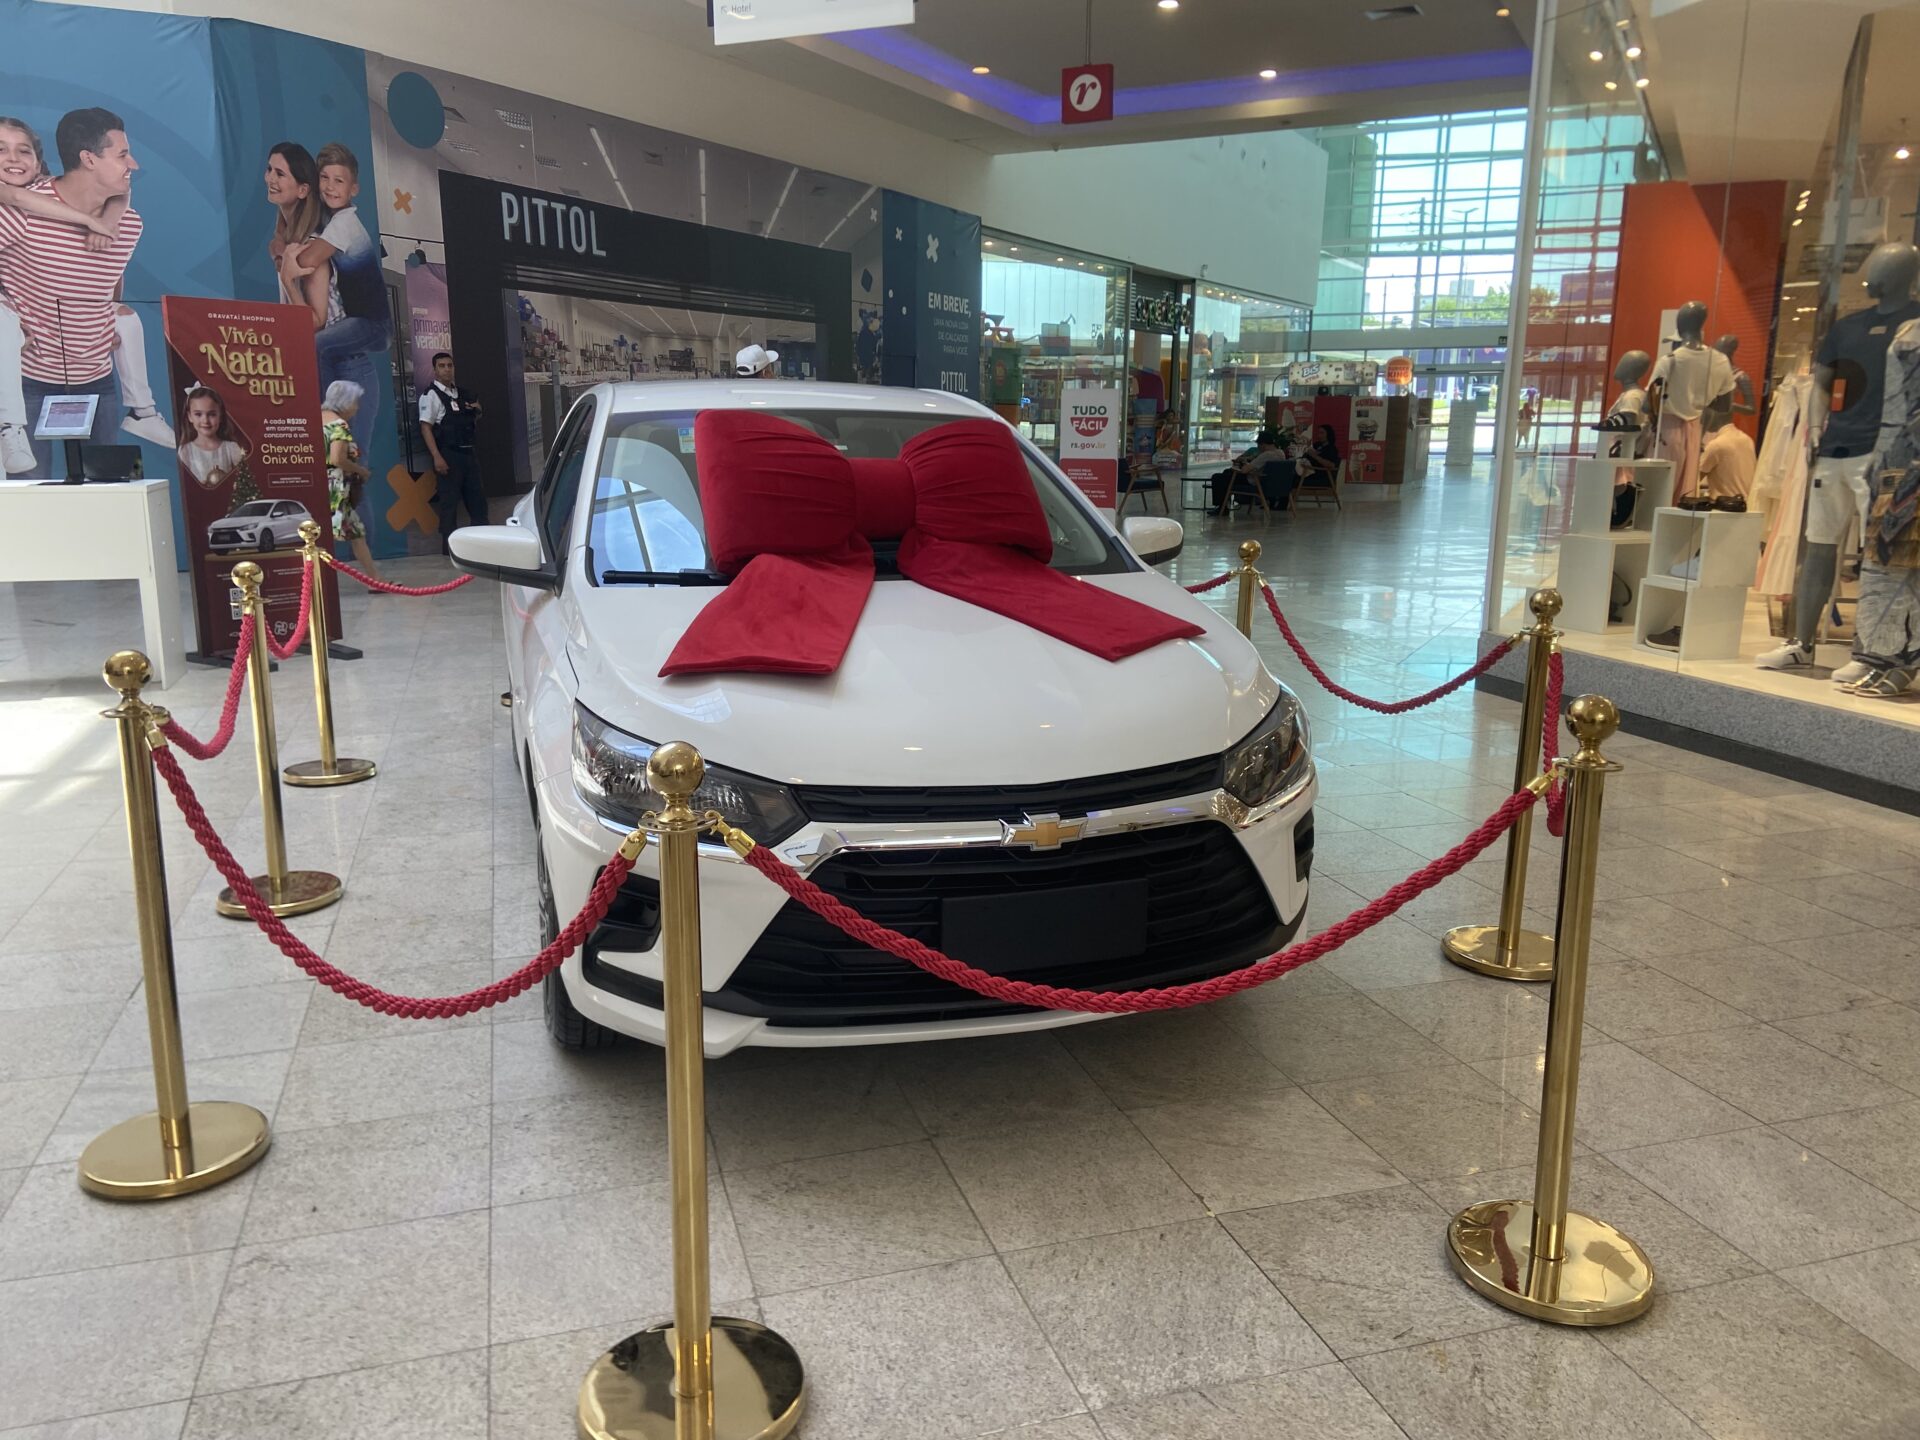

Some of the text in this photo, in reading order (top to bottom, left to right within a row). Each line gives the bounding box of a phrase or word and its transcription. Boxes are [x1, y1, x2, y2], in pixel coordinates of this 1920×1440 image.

[731, 3, 752, 13] Hotel
[501, 191, 607, 257] PITTOL
[928, 291, 972, 318] EM BREVE,
[242, 314, 276, 323] SHOPPING
[261, 333, 273, 346] o
[200, 343, 285, 385] Natal
[941, 371, 969, 393] PITTOL
[249, 376, 296, 405] aqui
[1072, 405, 1108, 416] TUDO
[1073, 418, 1105, 431] FÁCIL
[261, 443, 314, 454] Chevrolet
[1070, 441, 1106, 451] rs.gov.br
[262, 454, 314, 464] Onix 0km
